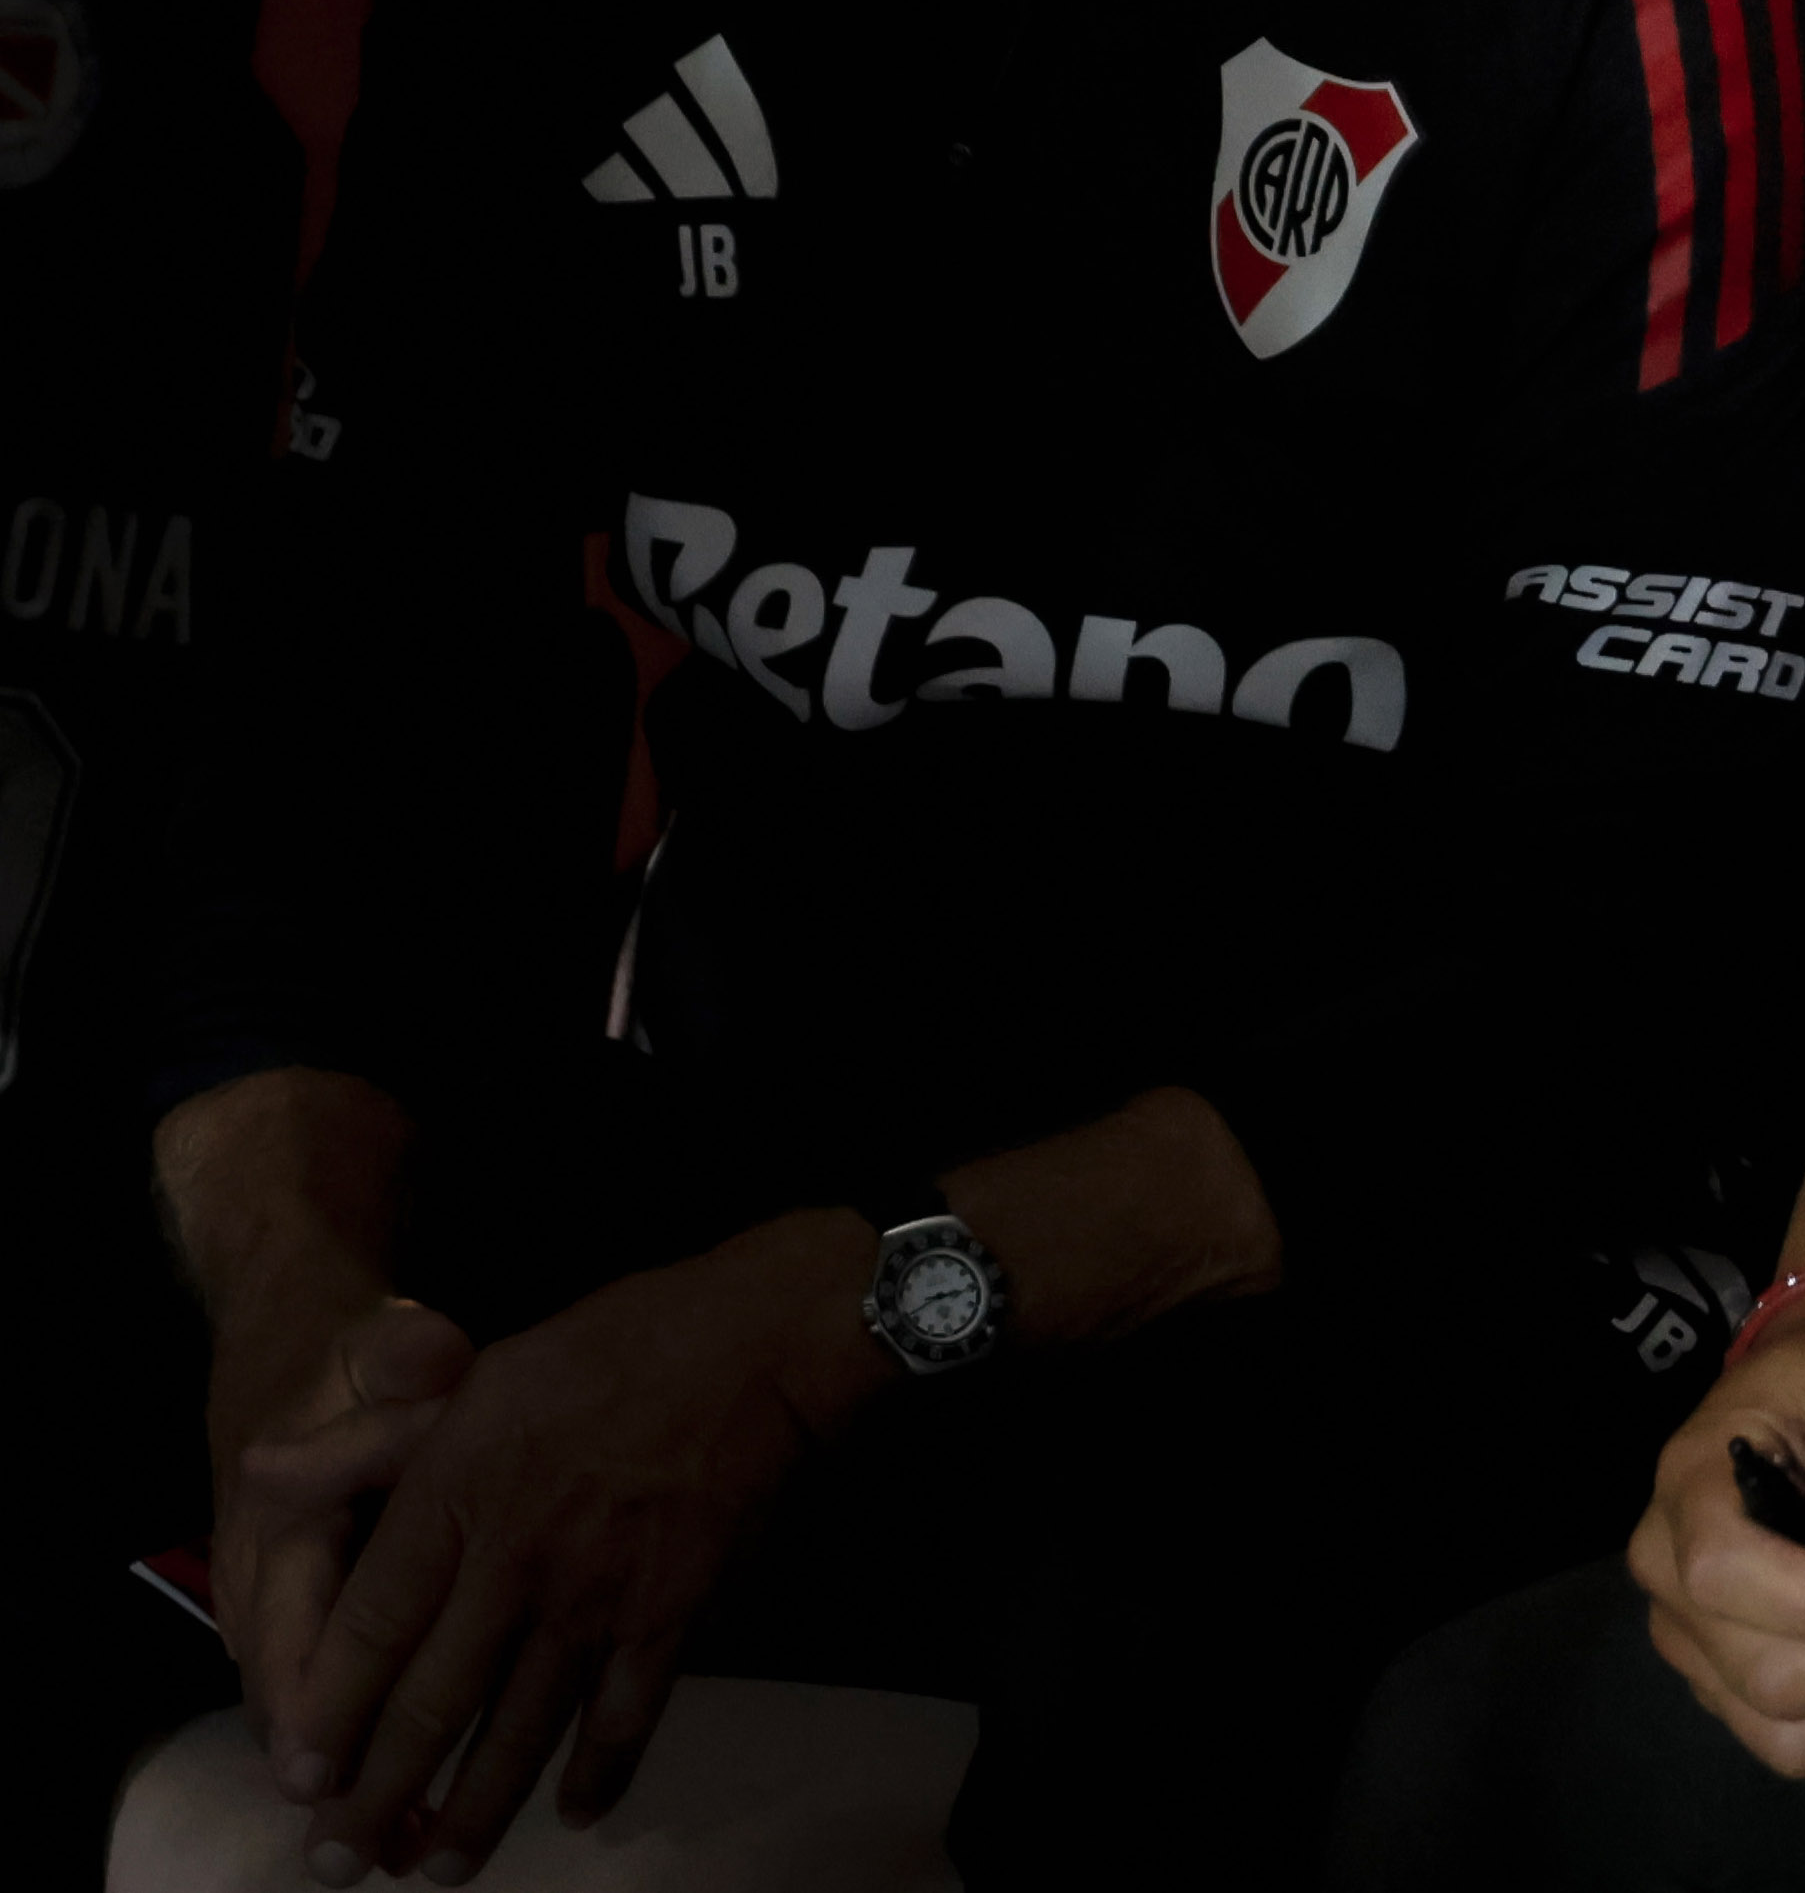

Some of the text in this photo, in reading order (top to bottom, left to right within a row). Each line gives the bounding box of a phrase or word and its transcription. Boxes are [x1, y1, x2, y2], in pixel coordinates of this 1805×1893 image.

[677, 222, 741, 299] JB
[1504, 563, 1805, 638] ASSIST
[1611, 1291, 1699, 1374] JB
